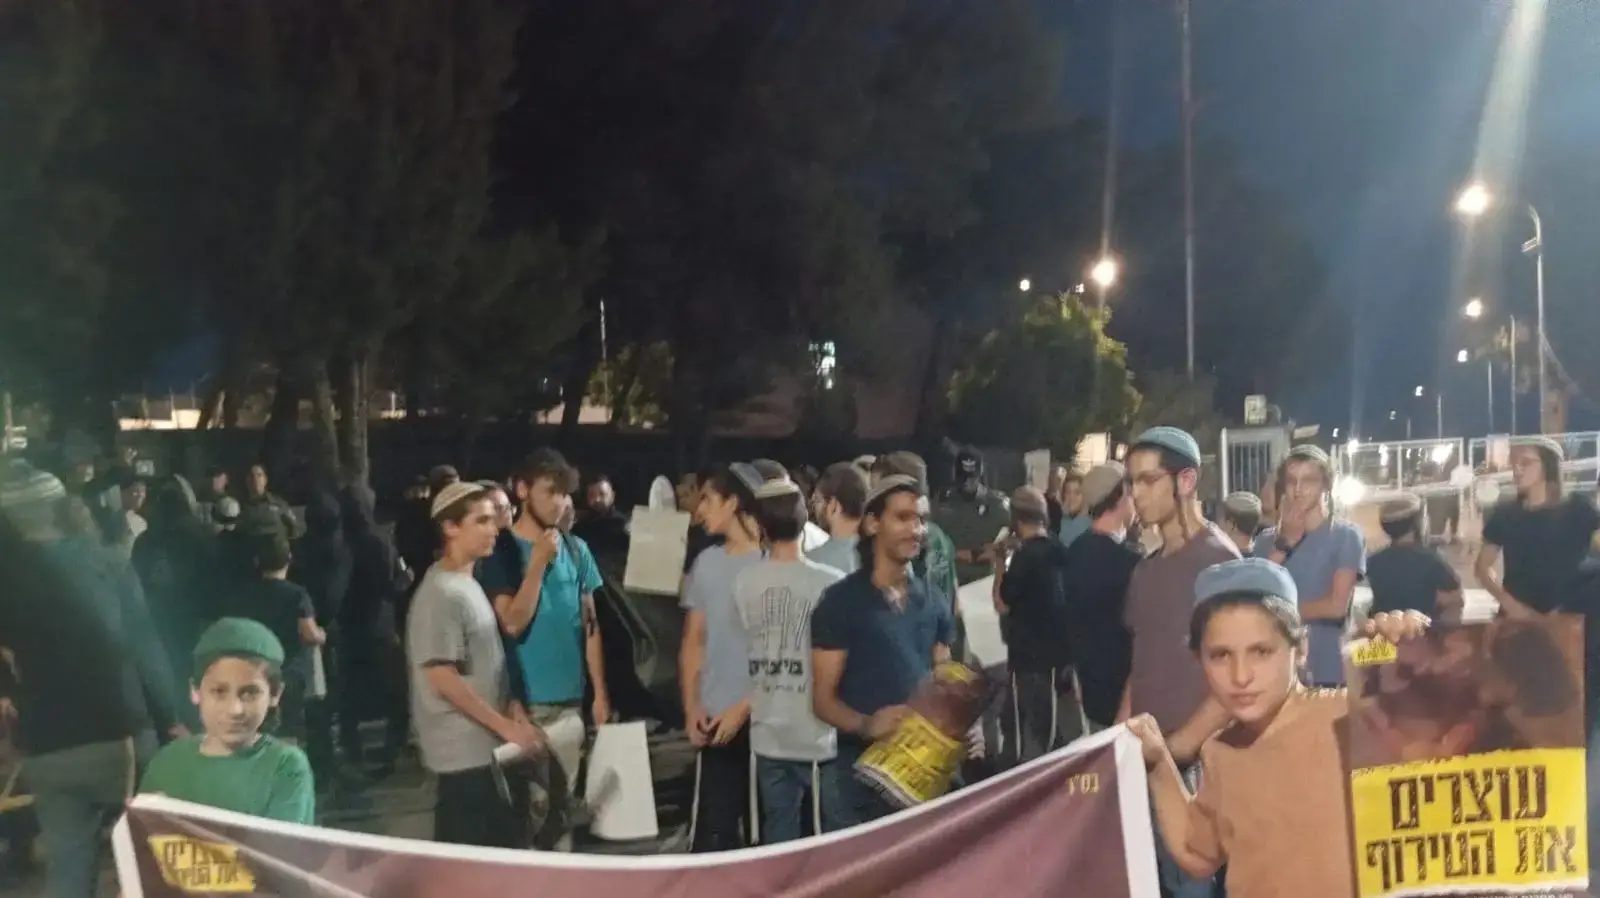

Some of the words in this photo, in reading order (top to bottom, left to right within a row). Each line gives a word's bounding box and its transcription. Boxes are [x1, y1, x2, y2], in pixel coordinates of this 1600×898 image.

[1388, 764, 1547, 831] עוצרים
[1365, 828, 1496, 891] הטירוף
[1514, 825, 1578, 875] את
